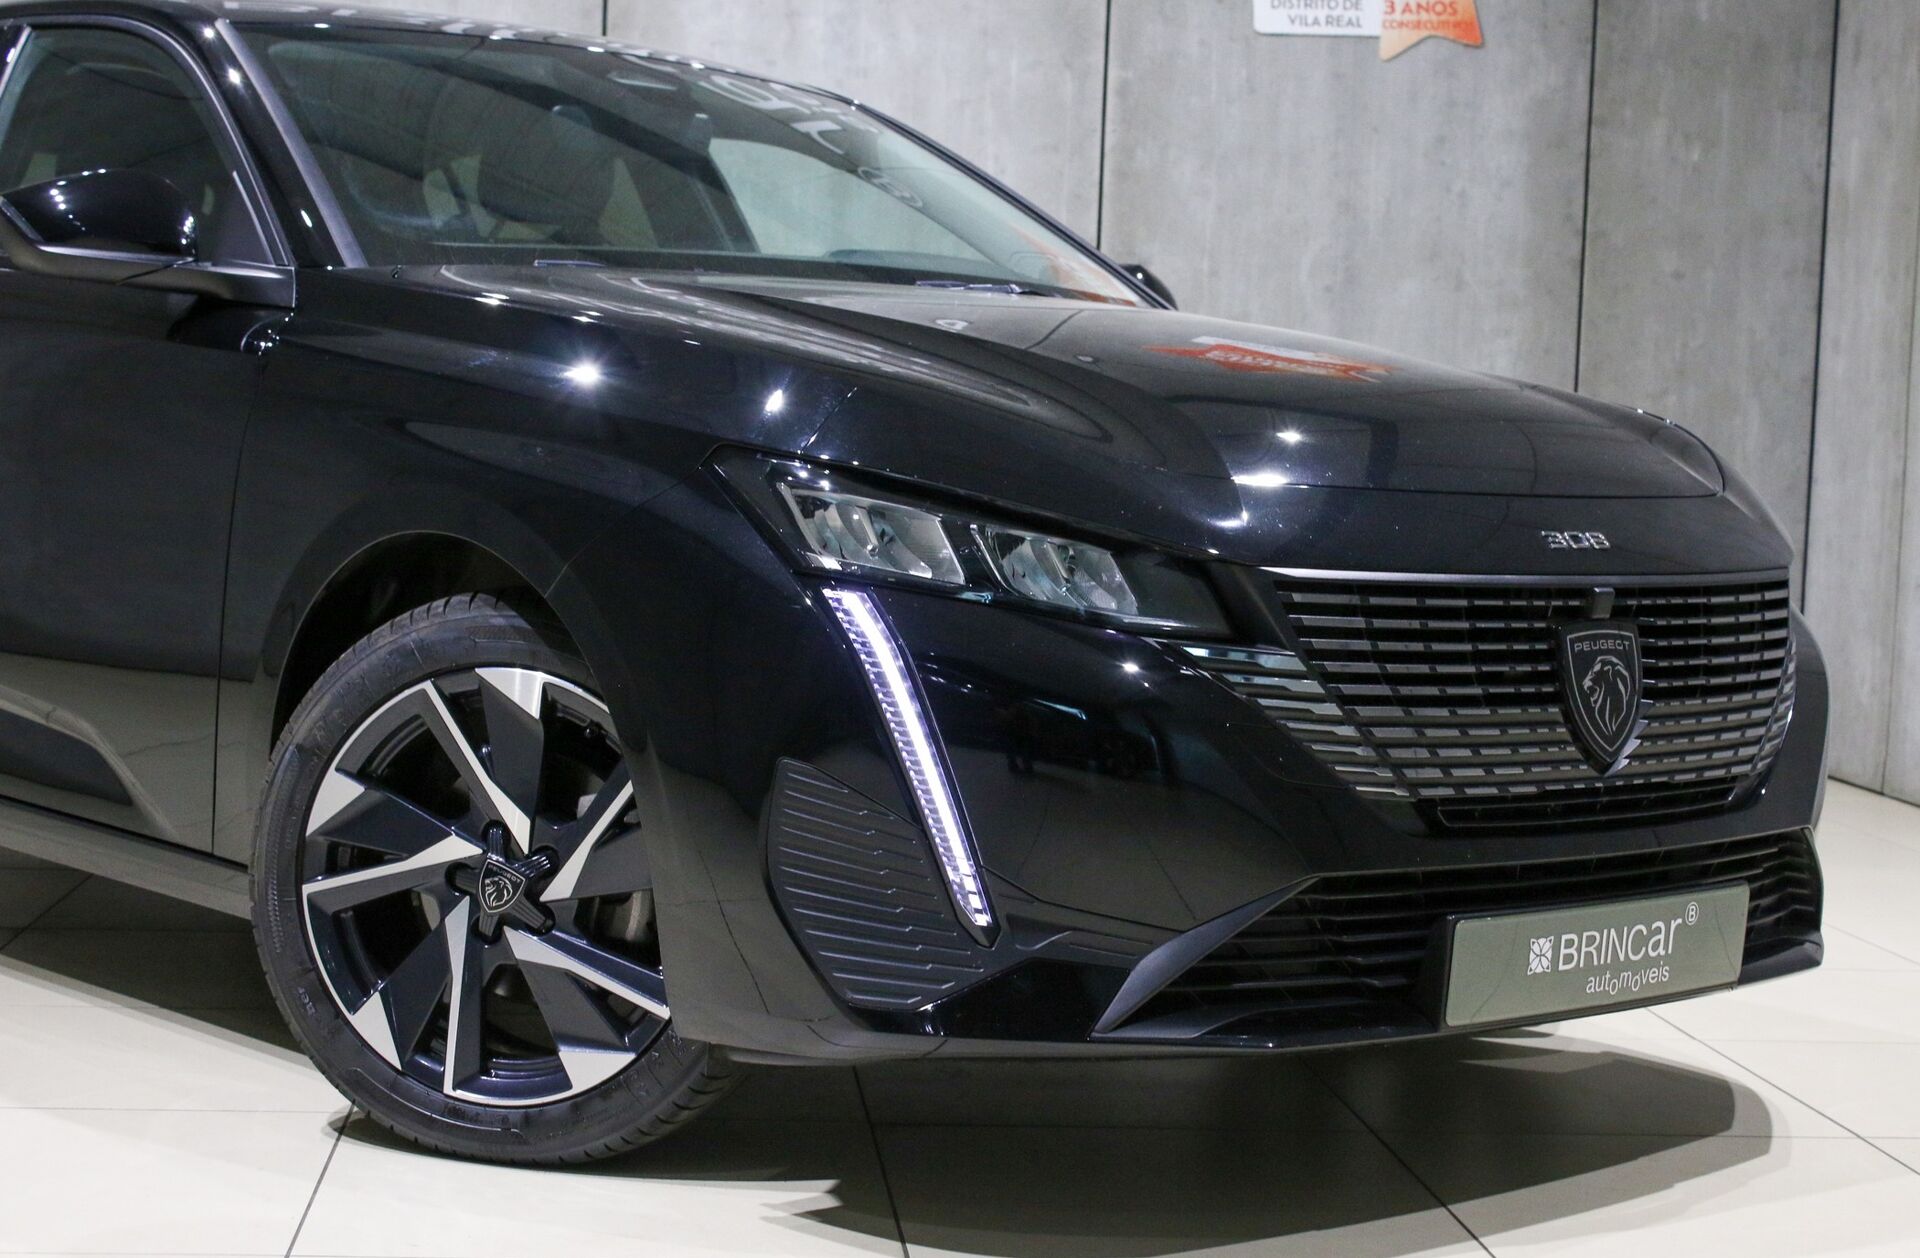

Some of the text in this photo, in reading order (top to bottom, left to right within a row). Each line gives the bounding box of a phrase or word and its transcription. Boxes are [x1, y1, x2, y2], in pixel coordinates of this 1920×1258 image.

[1270, 0, 1363, 11] DISTRITO DE
[1384, 0, 1458, 16] 3 ANOS
[1287, 14, 1363, 28] VILA REAL
[1541, 530, 1611, 549] 308
[1574, 639, 1631, 653] PEUGEOT
